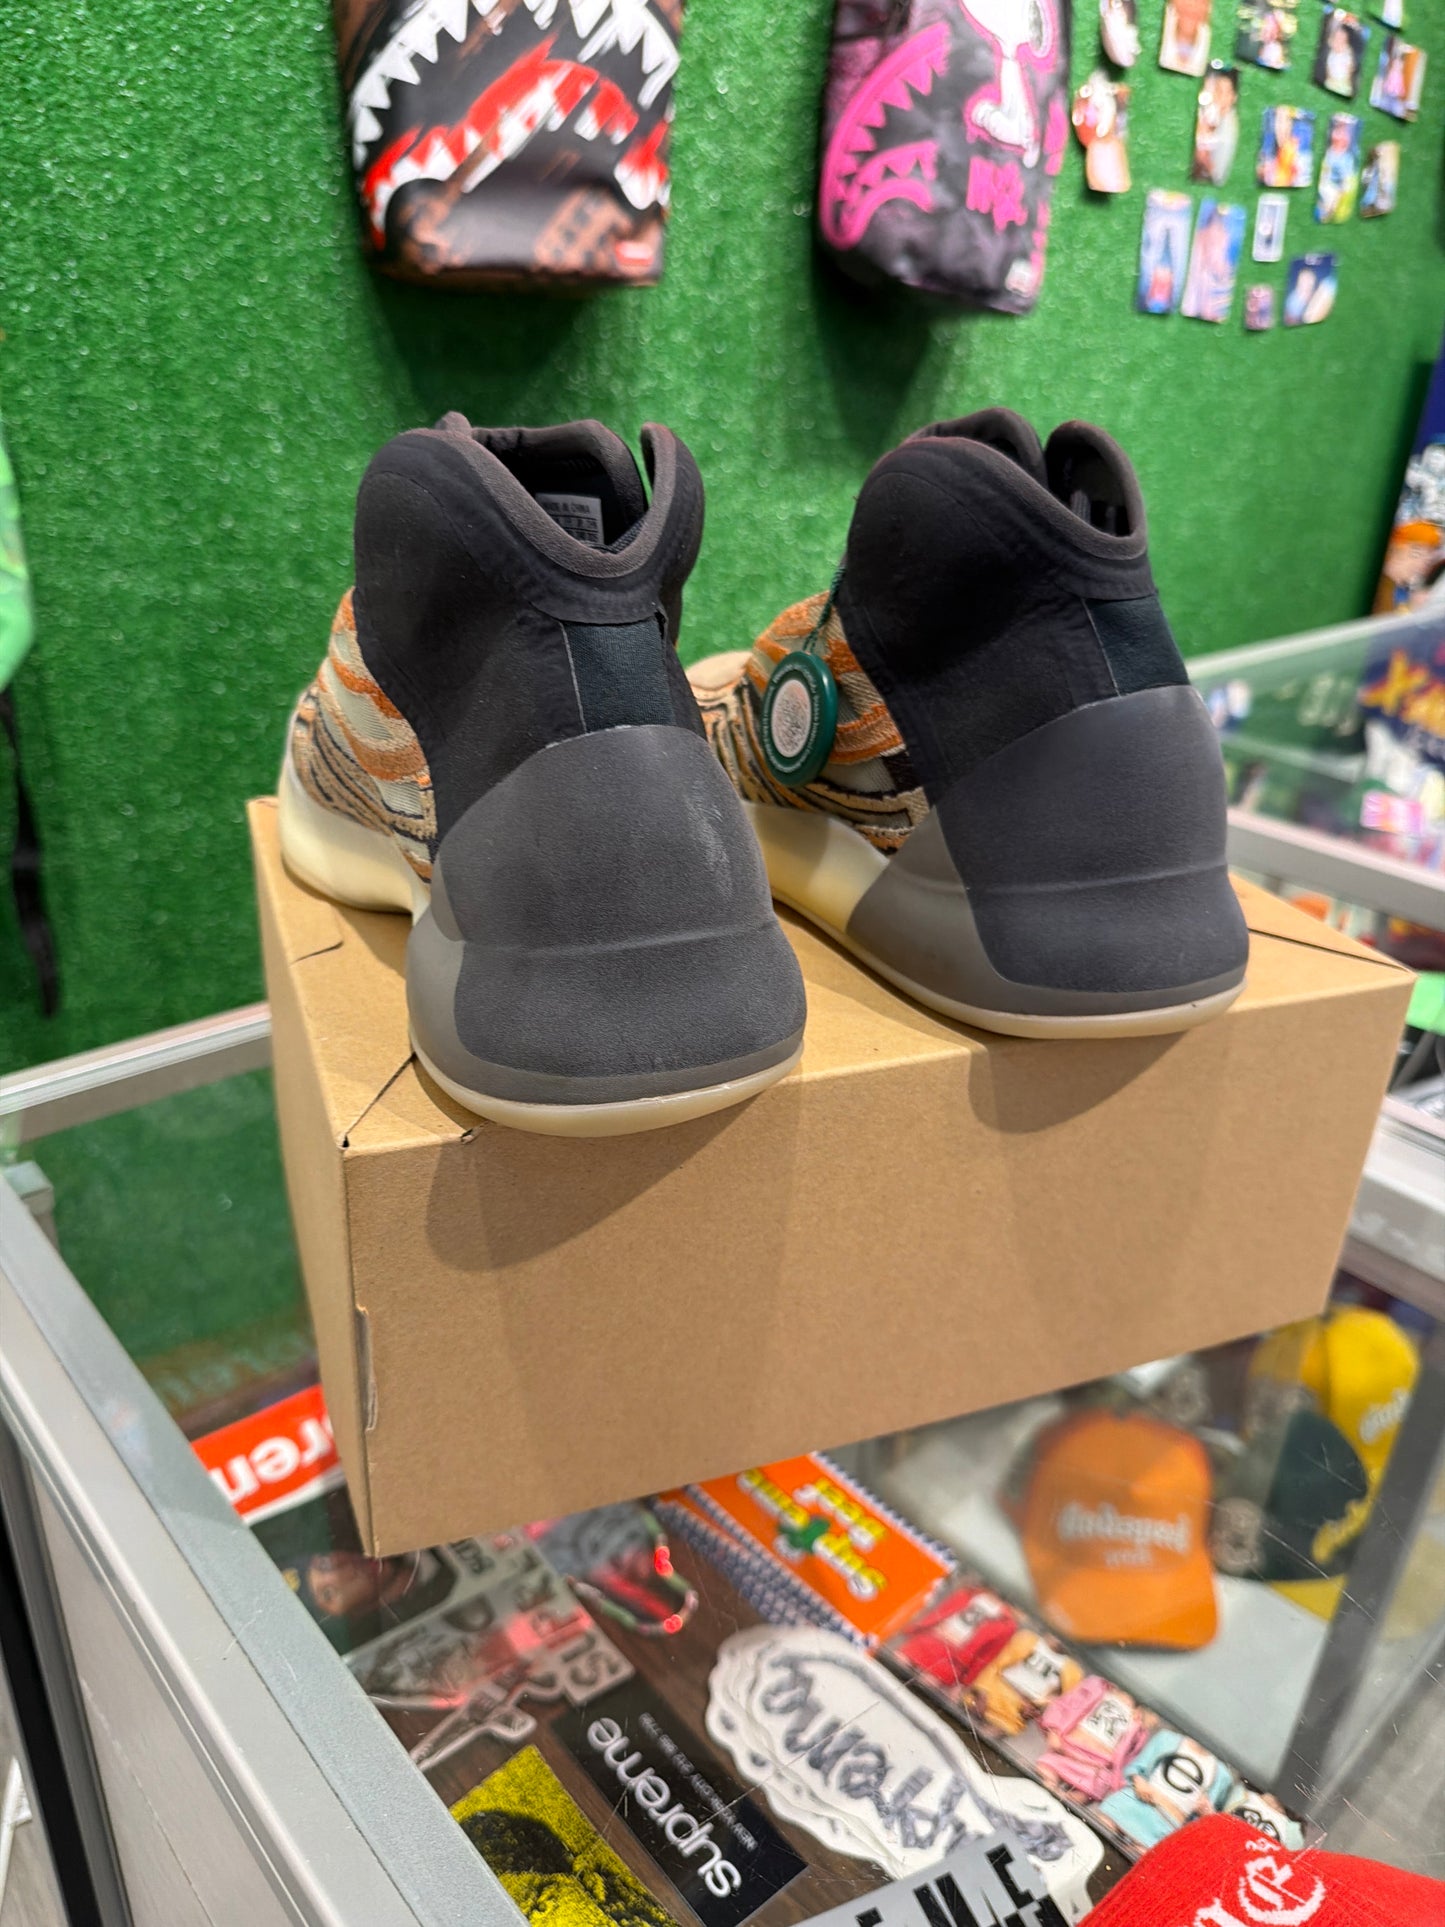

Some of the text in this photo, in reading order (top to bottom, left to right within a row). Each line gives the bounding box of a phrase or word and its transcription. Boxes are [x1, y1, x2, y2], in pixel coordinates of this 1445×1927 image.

[738, 1469, 886, 1598] Supeme
[586, 1719, 742, 1896] supreme
[730, 1820, 760, 1853] NEW
